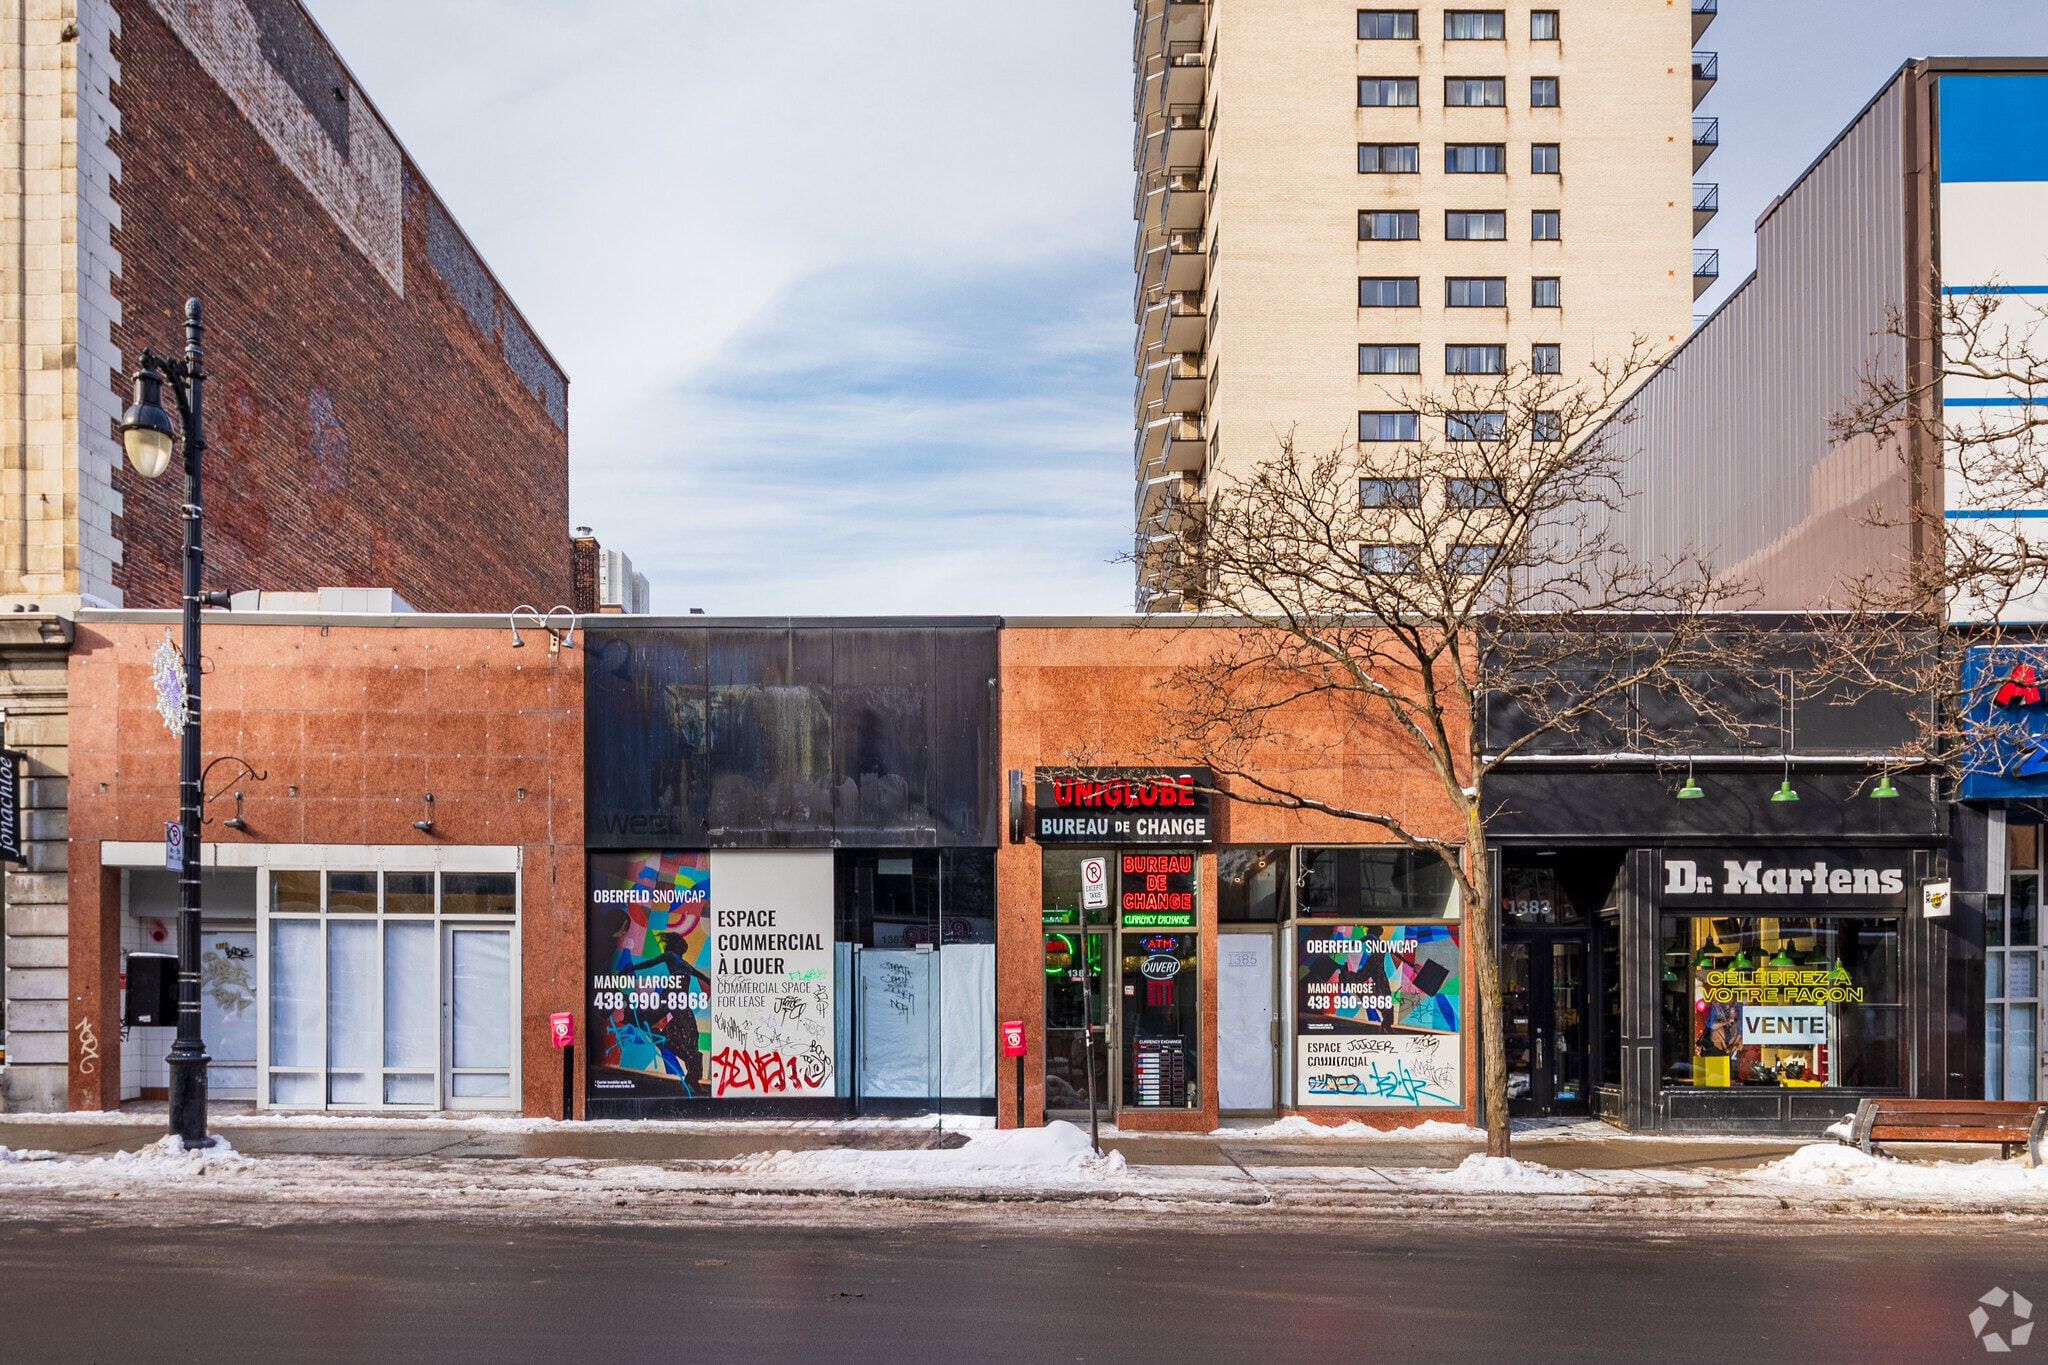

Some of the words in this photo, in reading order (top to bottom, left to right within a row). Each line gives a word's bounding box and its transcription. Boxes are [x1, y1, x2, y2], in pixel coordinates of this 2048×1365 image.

[1054, 776, 1195, 807] UNIGLOBE
[1041, 818, 1109, 835] BUREAU
[1115, 821, 1130, 833] DE
[1136, 818, 1206, 835] CHANGE
[1123, 856, 1192, 873] BUREAU
[1146, 874, 1167, 891] DE
[1664, 860, 1713, 894] Dr.
[1723, 860, 1904, 894] Martens
[593, 889, 650, 904] OBERFELD
[652, 889, 706, 904] SNOWCAP
[1123, 893, 1192, 910] CHANGE
[1508, 900, 1551, 915] 1383
[718, 910, 777, 927] ESPACE
[1124, 915, 1157, 925] CURRENCY
[1157, 915, 1191, 925] EXCHANGE
[718, 933, 824, 951] COMMERCIAL
[882, 935, 904, 945] 1387
[1148, 939, 1173, 949] ATM
[1306, 939, 1363, 954] OBERFELD
[1365, 939, 1418, 954] SNOWCAP
[718, 953, 728, 975] À
[734, 957, 785, 975] LOUER
[1229, 953, 1257, 966] 1385
[1143, 961, 1178, 974] OUVERT
[594, 975, 636, 989] MANON
[1706, 967, 1829, 987] CÉLÉBREZ
[717, 982, 779, 994] COMMERCIAL
[781, 982, 811, 994] SPACE
[1307, 983, 1339, 994] MANON
[593, 992, 624, 1010] 438
[628, 992, 709, 1010] 990-8968
[717, 996, 736, 1008] FOR
[738, 996, 766, 1008] LEASE
[1307, 995, 1331, 1010] 438
[1333, 995, 1393, 1010] 990-8968
[1701, 987, 1779, 1003] VOTRE
[1783, 987, 1864, 1006] FAÇON
[1745, 1016, 1825, 1034] VENTE
[1307, 1042, 1342, 1053] ESPACE
